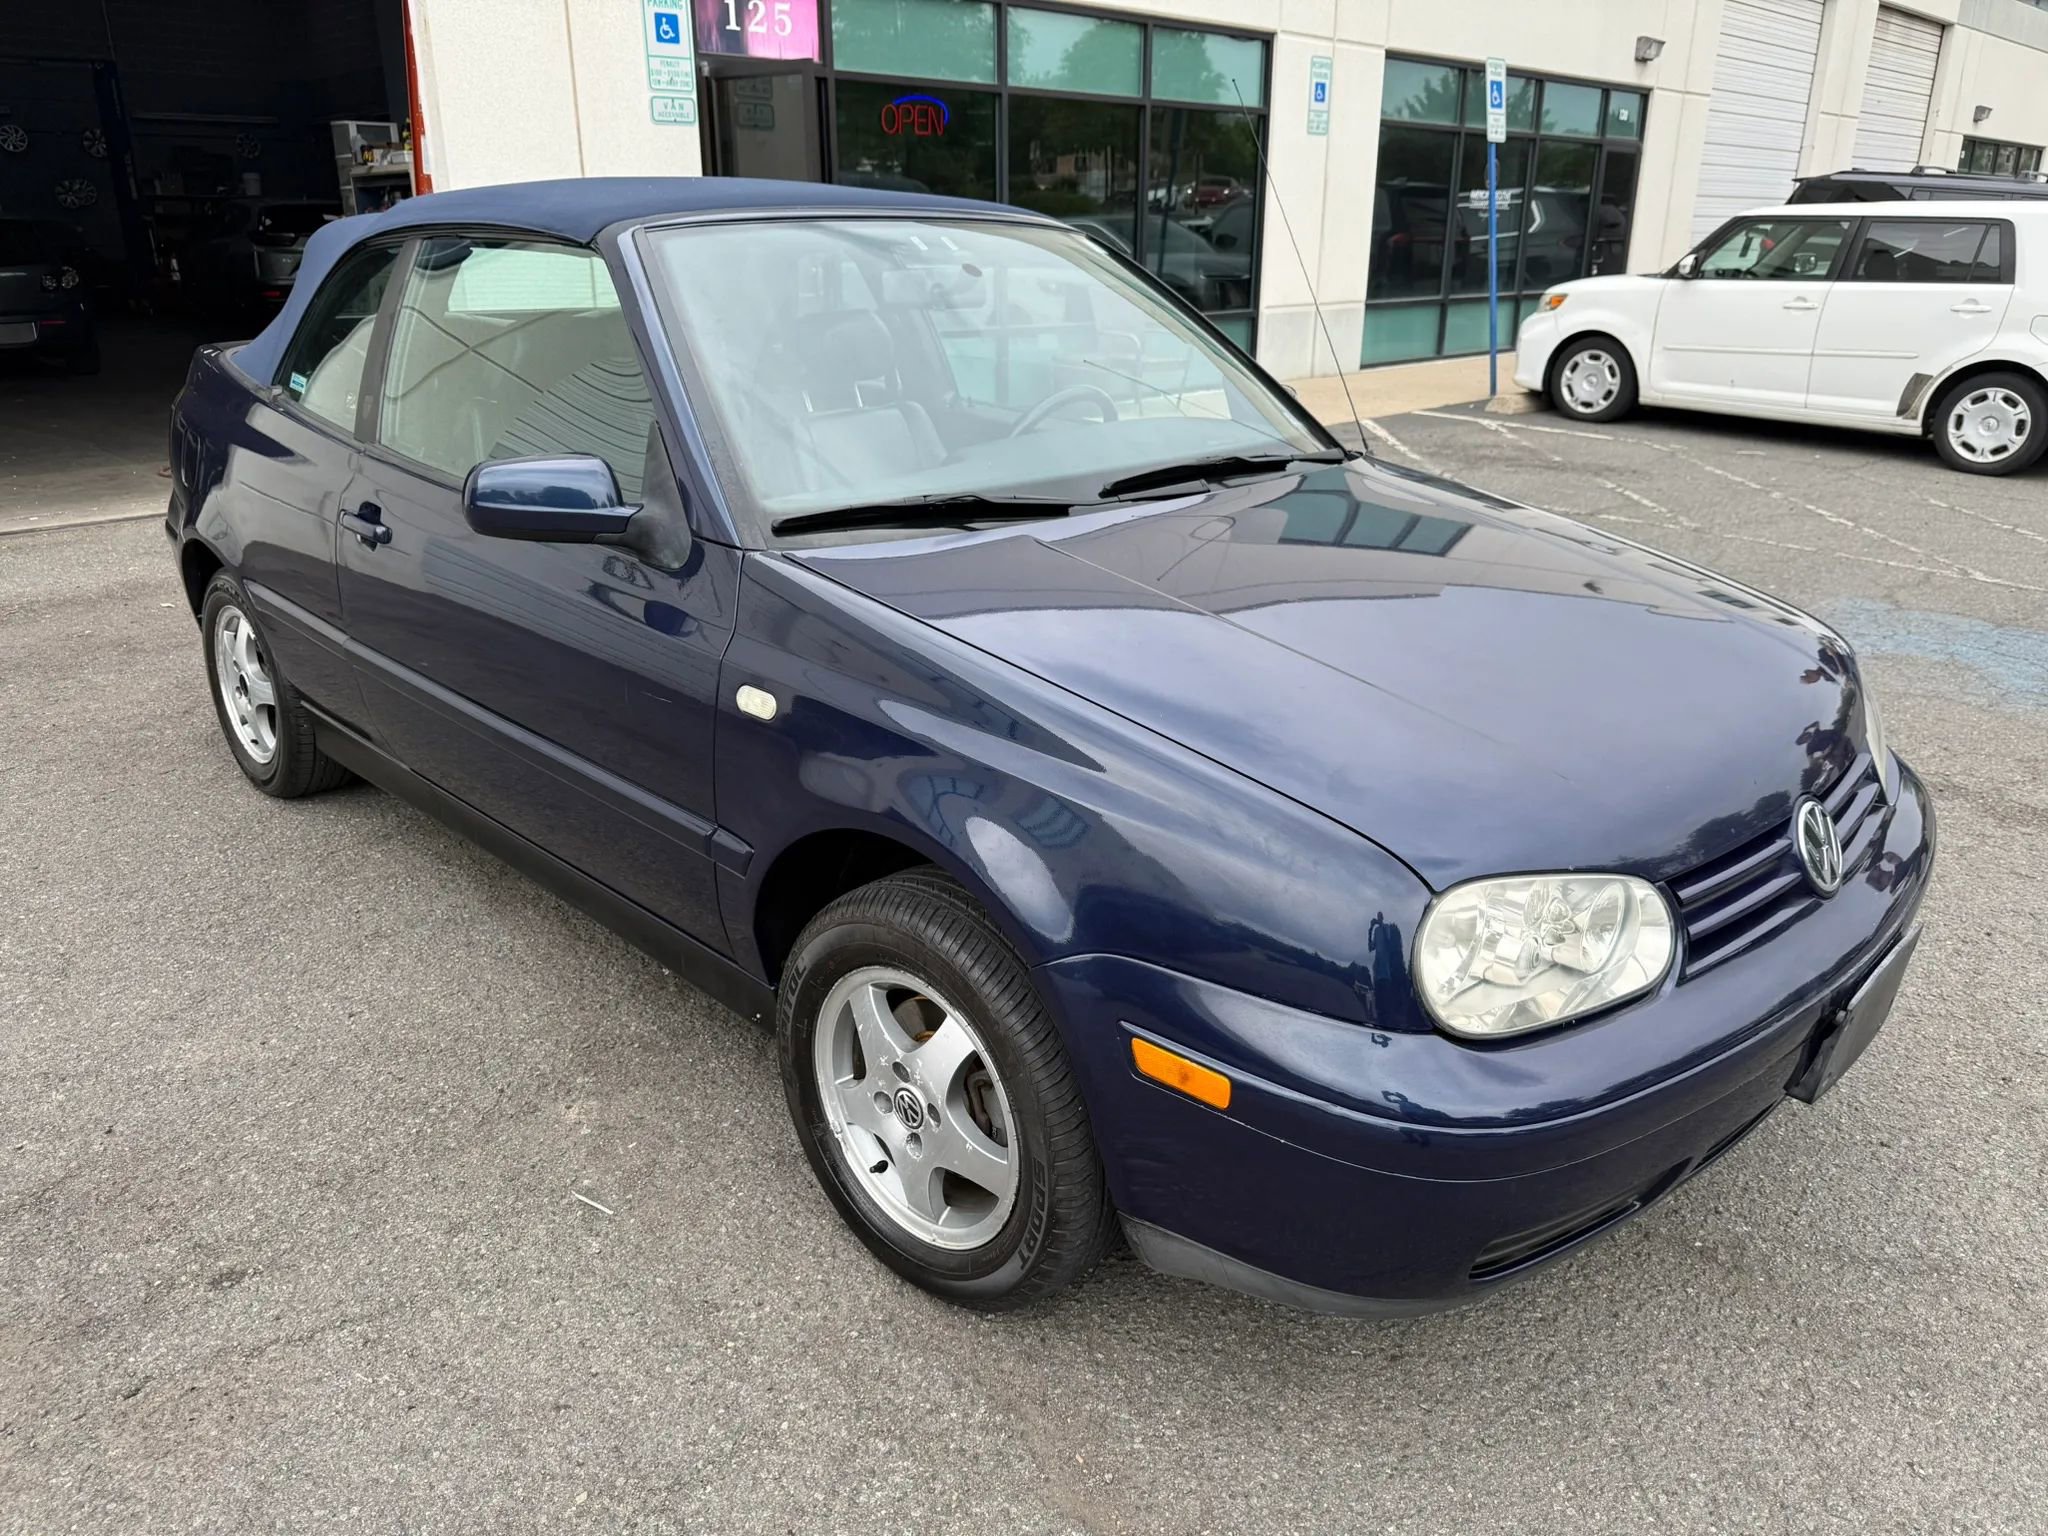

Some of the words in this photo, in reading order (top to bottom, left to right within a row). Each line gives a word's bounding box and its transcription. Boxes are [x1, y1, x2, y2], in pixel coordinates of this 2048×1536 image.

[647, 0, 684, 10] PARKING
[724, 0, 793, 36] 125
[663, 102, 685, 111] VAN
[881, 103, 945, 136] OPEN
[1017, 1157, 1049, 1271] SPORT
